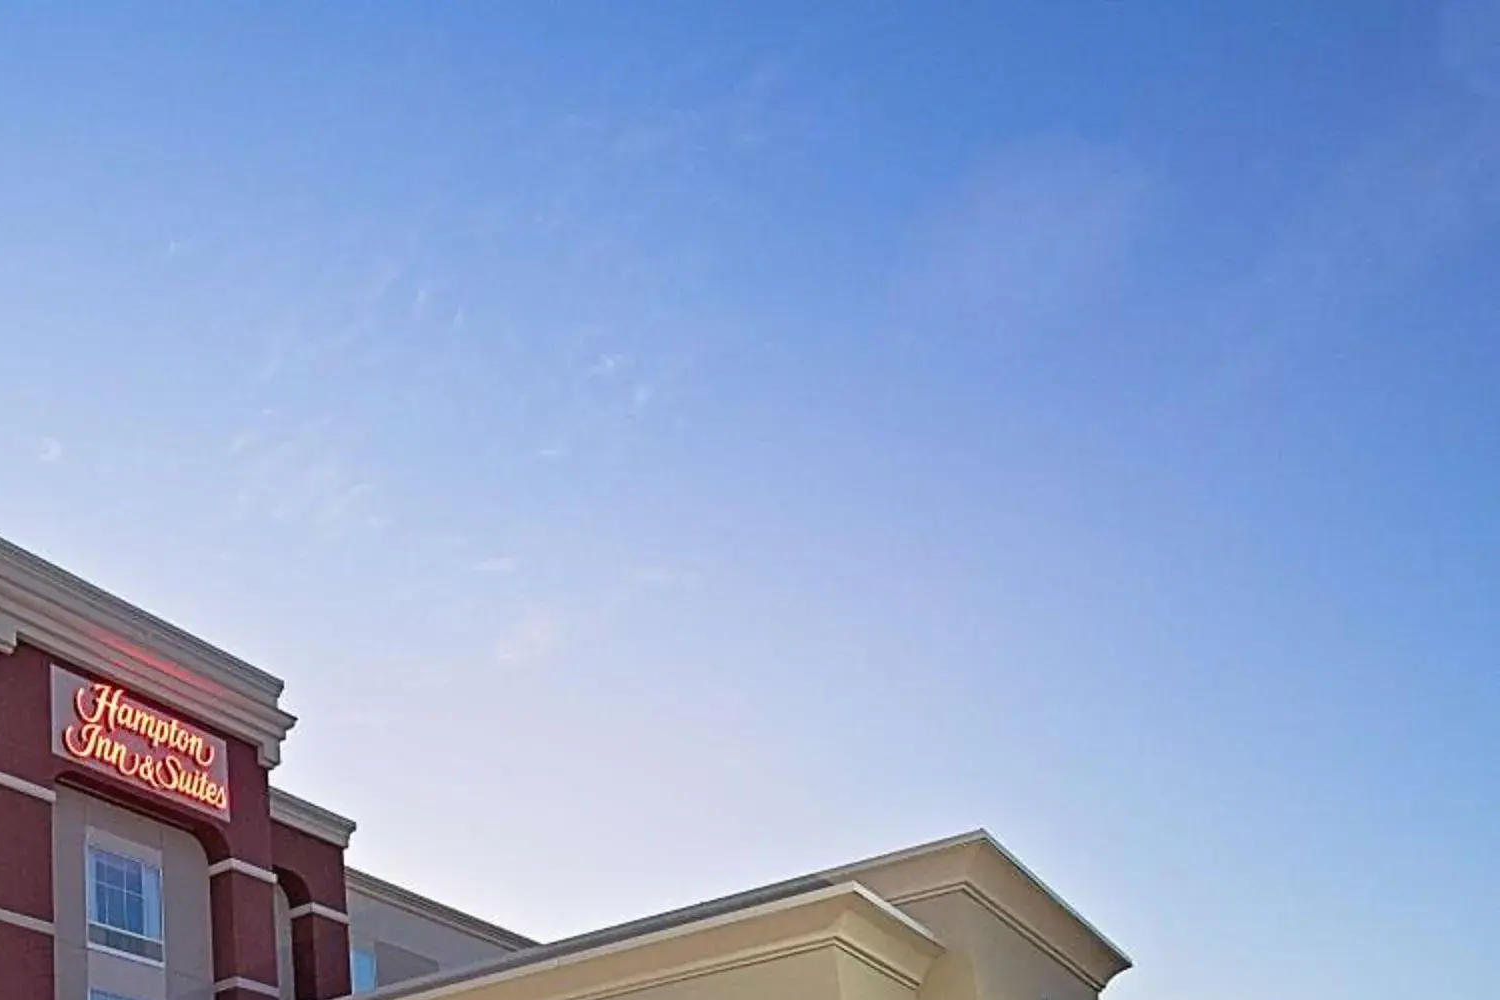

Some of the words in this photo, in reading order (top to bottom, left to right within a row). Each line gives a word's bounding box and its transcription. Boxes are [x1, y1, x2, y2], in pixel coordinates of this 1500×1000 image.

[65, 723, 140, 776] Inn
[140, 754, 159, 787] &
[156, 755, 227, 809] Suites
[77, 683, 215, 767] Hampton
